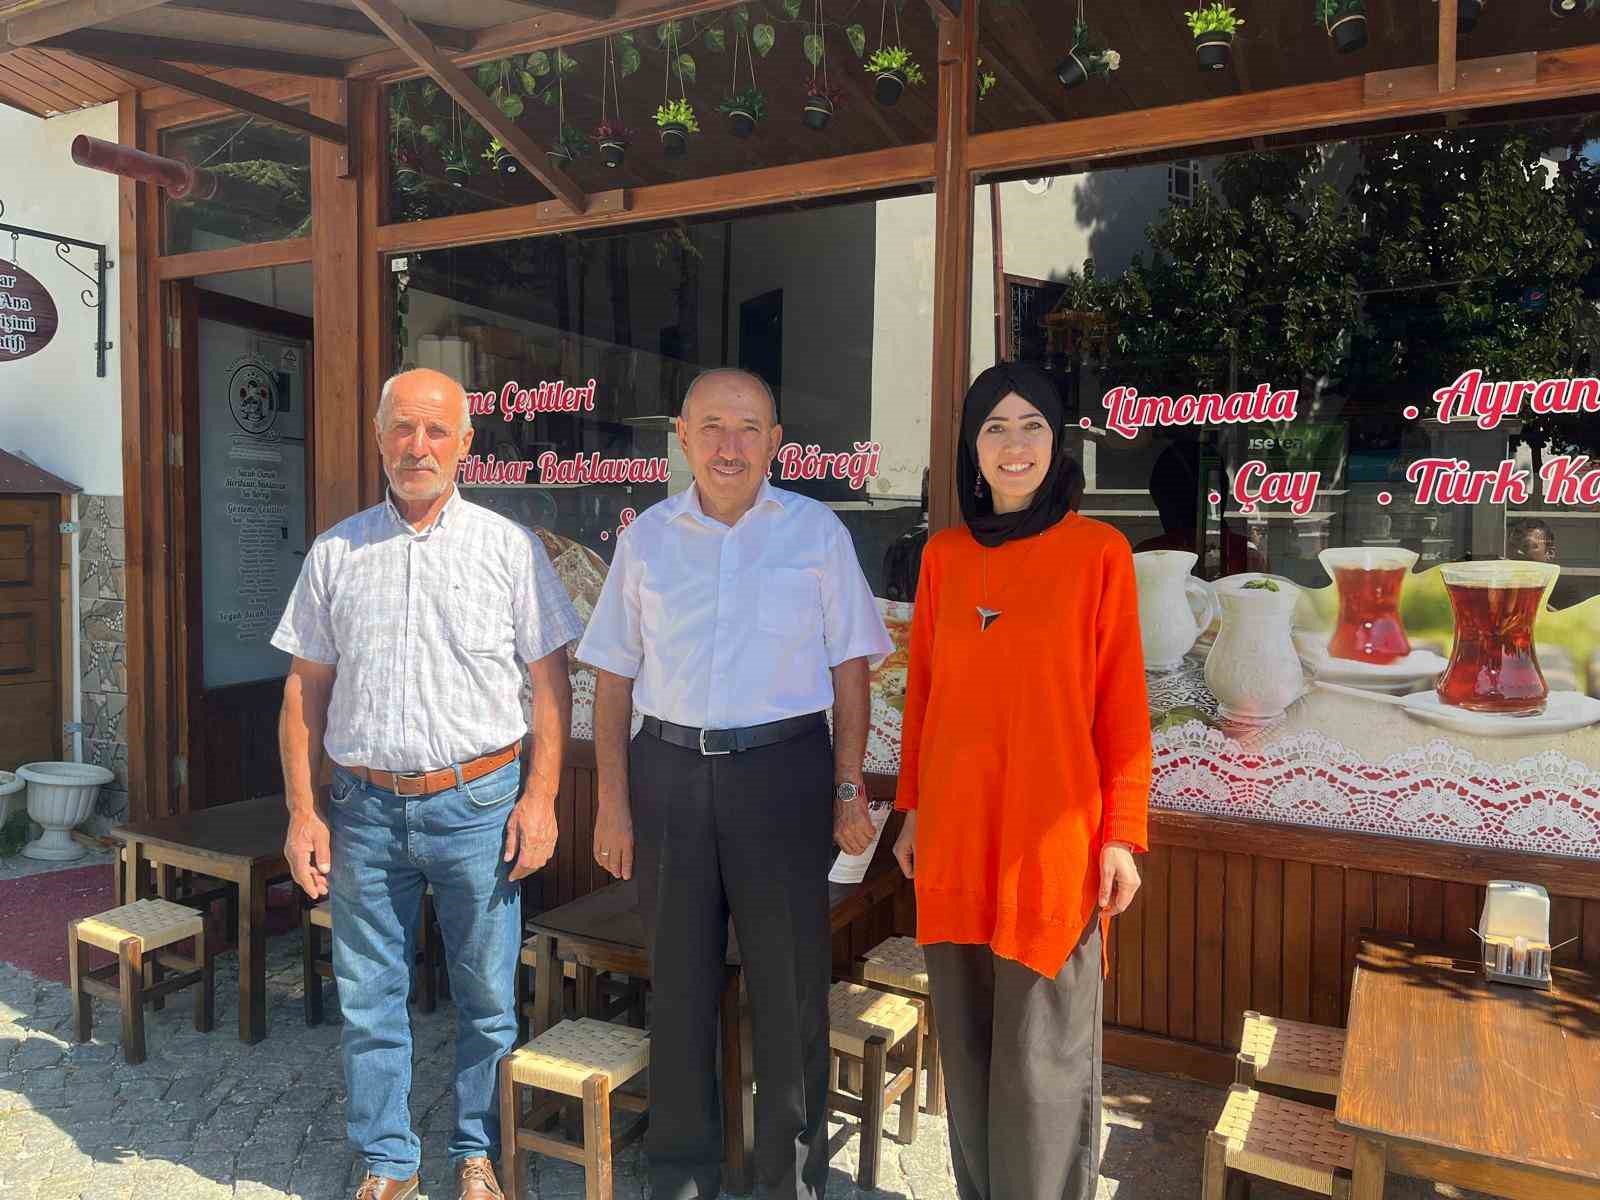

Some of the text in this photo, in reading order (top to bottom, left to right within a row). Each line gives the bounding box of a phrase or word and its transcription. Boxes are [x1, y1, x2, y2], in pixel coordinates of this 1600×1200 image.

[0, 275, 16, 288] ar
[500, 378, 597, 421] Çeşitleri
[1103, 383, 1299, 440] Limonata
[1433, 369, 1600, 430] Ayran
[456, 451, 672, 485] rihisar Baklavası
[778, 441, 881, 490] Böreği
[1234, 460, 1321, 516] Çay
[1406, 455, 1600, 505] Türk Ka
